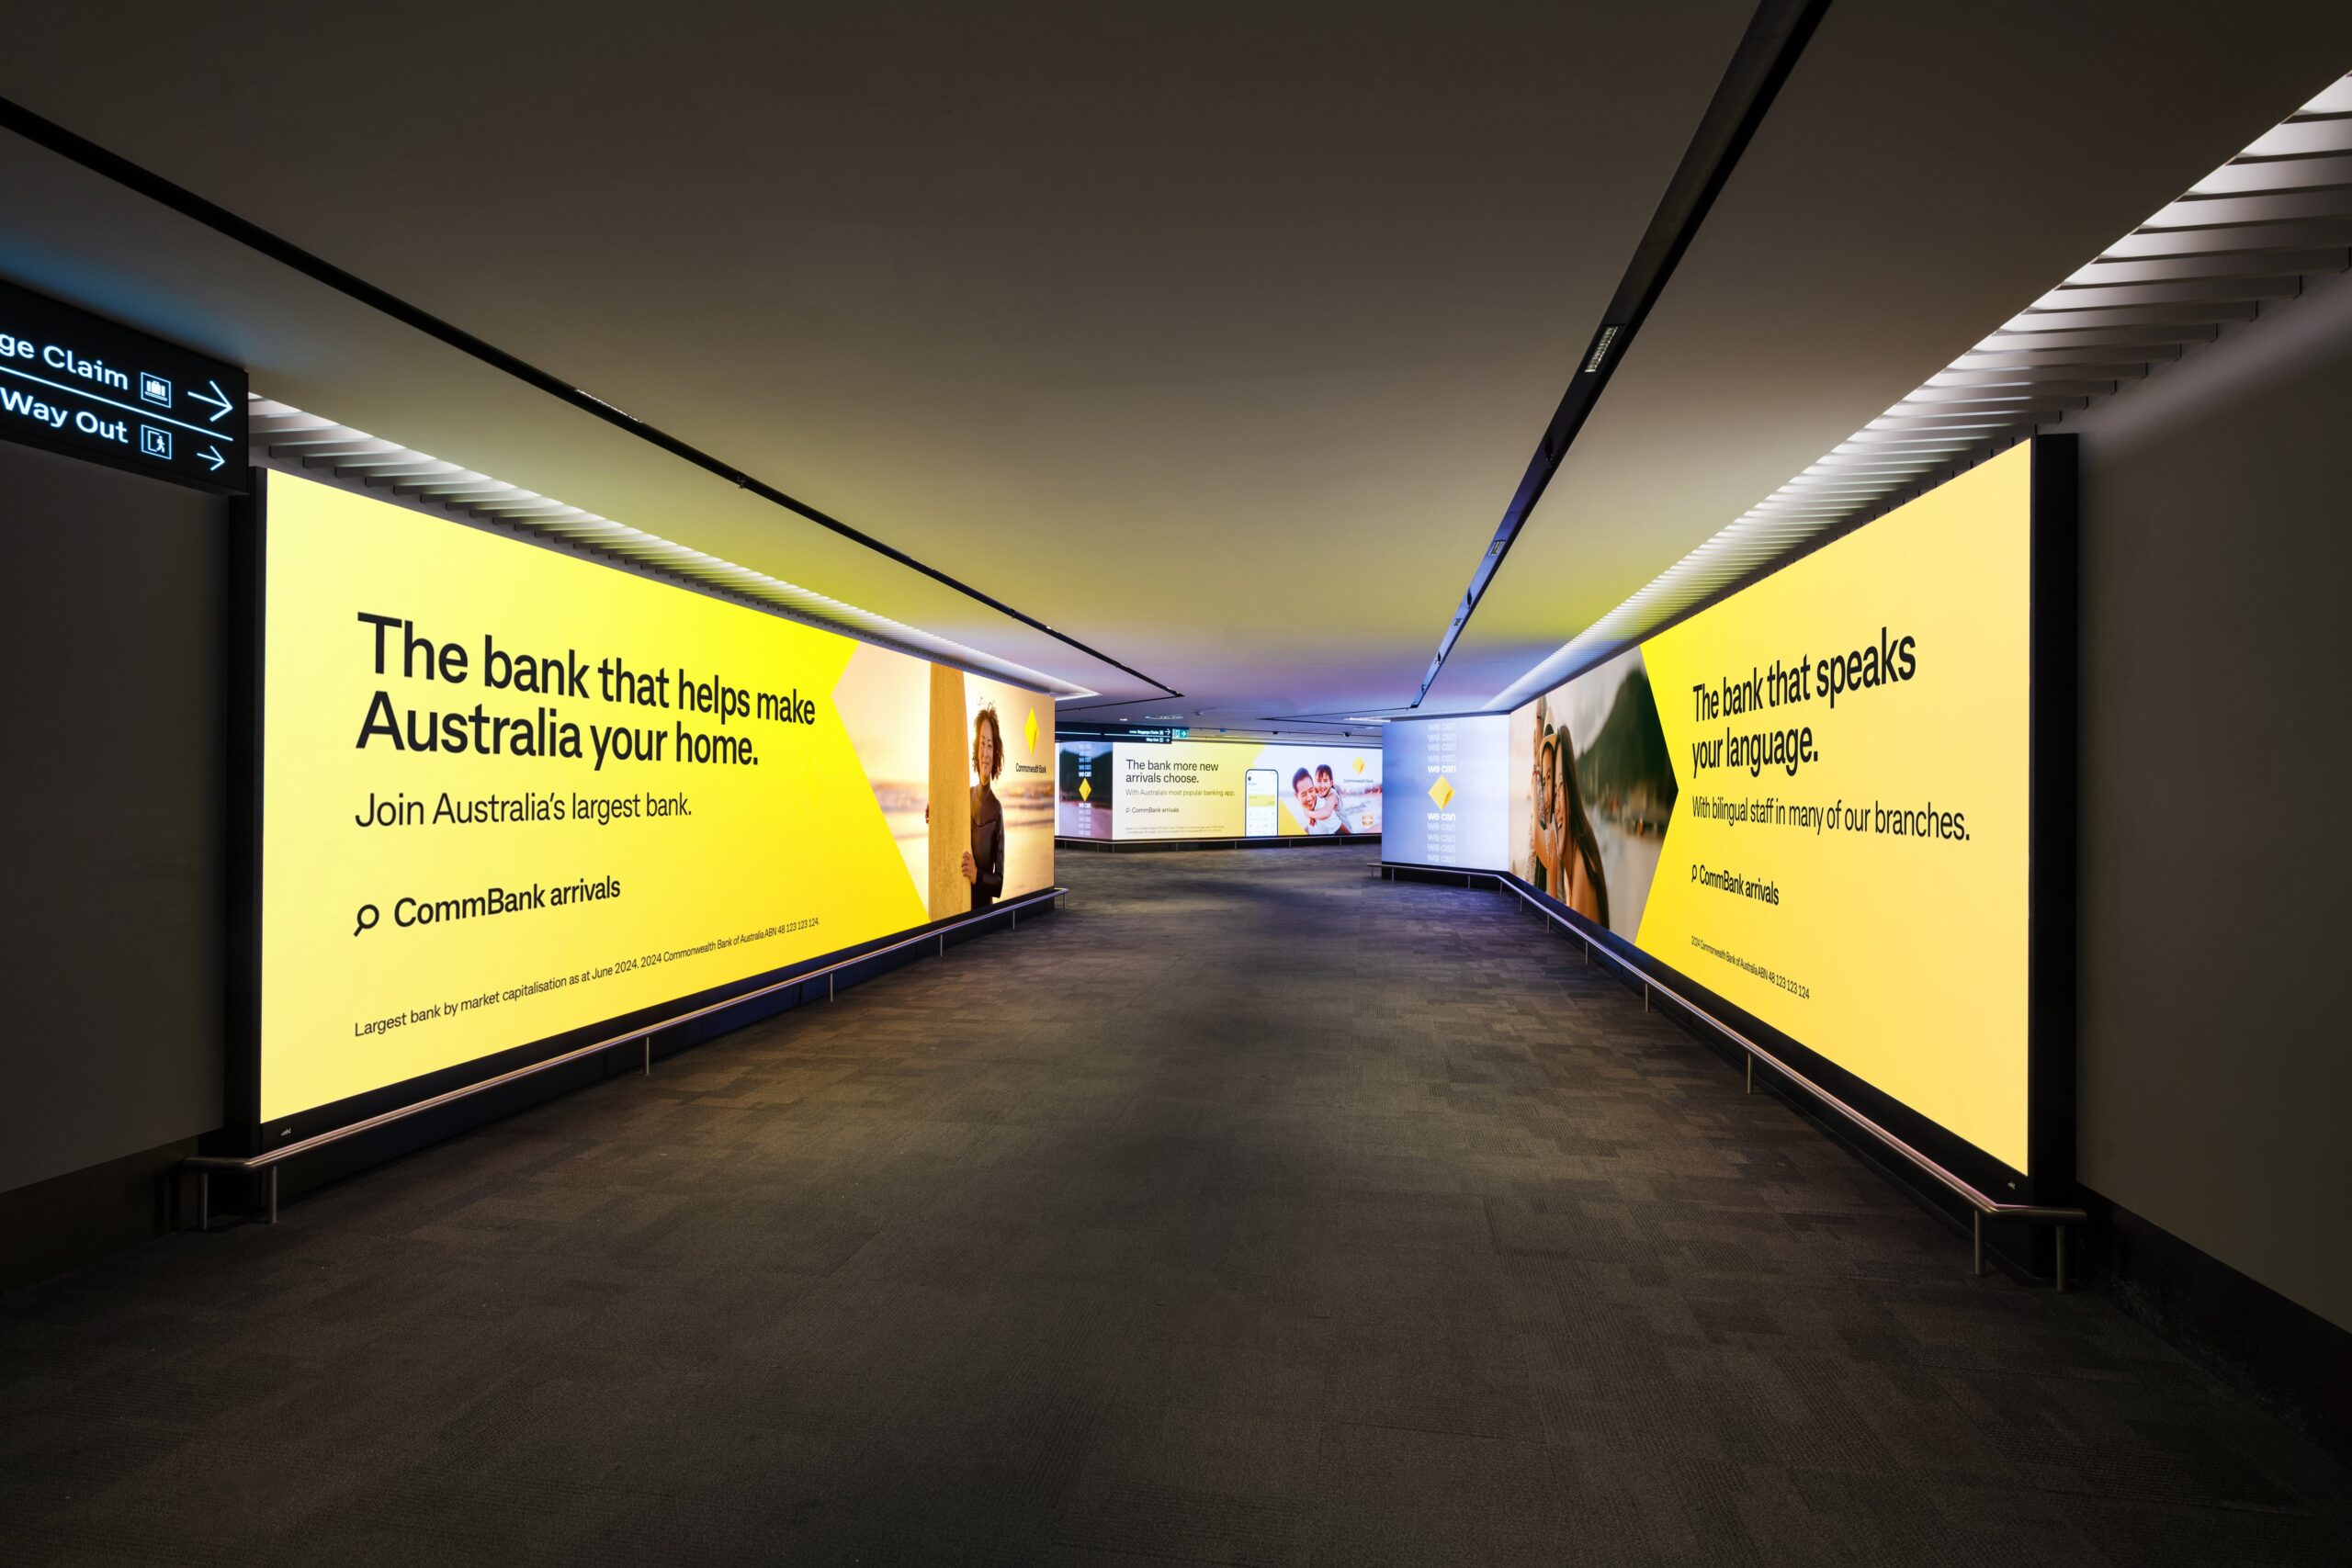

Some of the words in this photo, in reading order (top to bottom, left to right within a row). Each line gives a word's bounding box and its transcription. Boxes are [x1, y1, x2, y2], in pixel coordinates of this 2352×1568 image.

[43, 345, 129, 390] Claim
[0, 387, 69, 428] Way
[75, 411, 129, 444] Out
[357, 612, 468, 683] The
[484, 634, 590, 699] bank
[597, 657, 669, 708] that
[679, 669, 751, 725] helps
[757, 688, 815, 725] make
[1692, 683, 1719, 722] The
[1723, 667, 1763, 716] bank
[1767, 654, 1811, 707] that
[1816, 626, 1917, 709] speaks
[356, 691, 582, 759] Australia
[590, 725, 668, 771] your
[676, 721, 758, 765] home.
[1692, 739, 1723, 778] your
[1726, 727, 1818, 778] language.
[1125, 759, 1145, 770] The
[1148, 760, 1171, 771] bank
[1173, 762, 1197, 772] more
[1200, 762, 1219, 772] new
[1125, 772, 1161, 783] arrivals
[1163, 773, 1199, 783] choose.
[1428, 765, 1440, 773] we
[1442, 765, 1455, 773] can
[356, 793, 424, 828] Join
[432, 793, 565, 824] Australia's
[572, 792, 640, 826] largest
[647, 792, 691, 817] bank.
[1428, 812, 1440, 821] we
[1692, 796, 1710, 818] With
[1713, 796, 1747, 827] bilingual
[1750, 797, 1774, 823] staff
[1776, 798, 1785, 825] in
[1789, 806, 1824, 835] many
[1826, 799, 1841, 829] of
[1845, 808, 1871, 832] our
[1875, 800, 1970, 840] branches.
[394, 884, 546, 928] CommBank
[550, 875, 620, 907] arrivals
[1700, 864, 1744, 896] CommBank
[1746, 878, 1779, 906] arrivals
[356, 1012, 407, 1037] Largest
[411, 1005, 441, 1023] bank
[444, 1002, 458, 1017] by
[461, 991, 500, 1011] market
[503, 977, 567, 1001] capitalisation
[569, 976, 579, 985] as
[582, 971, 590, 982] at
[592, 967, 613, 979] June
[615, 959, 639, 974] 2024.
[641, 953, 662, 967] 2024
[663, 942, 716, 962] Commonwealth
[718, 938, 732, 949] Bank
[733, 935, 740, 945] of
[740, 931, 763, 943] Australia
[764, 927, 776, 938] ABN
[778, 925, 785, 933] 48
[786, 922, 797, 932] 123
[797, 919, 808, 930] 123
